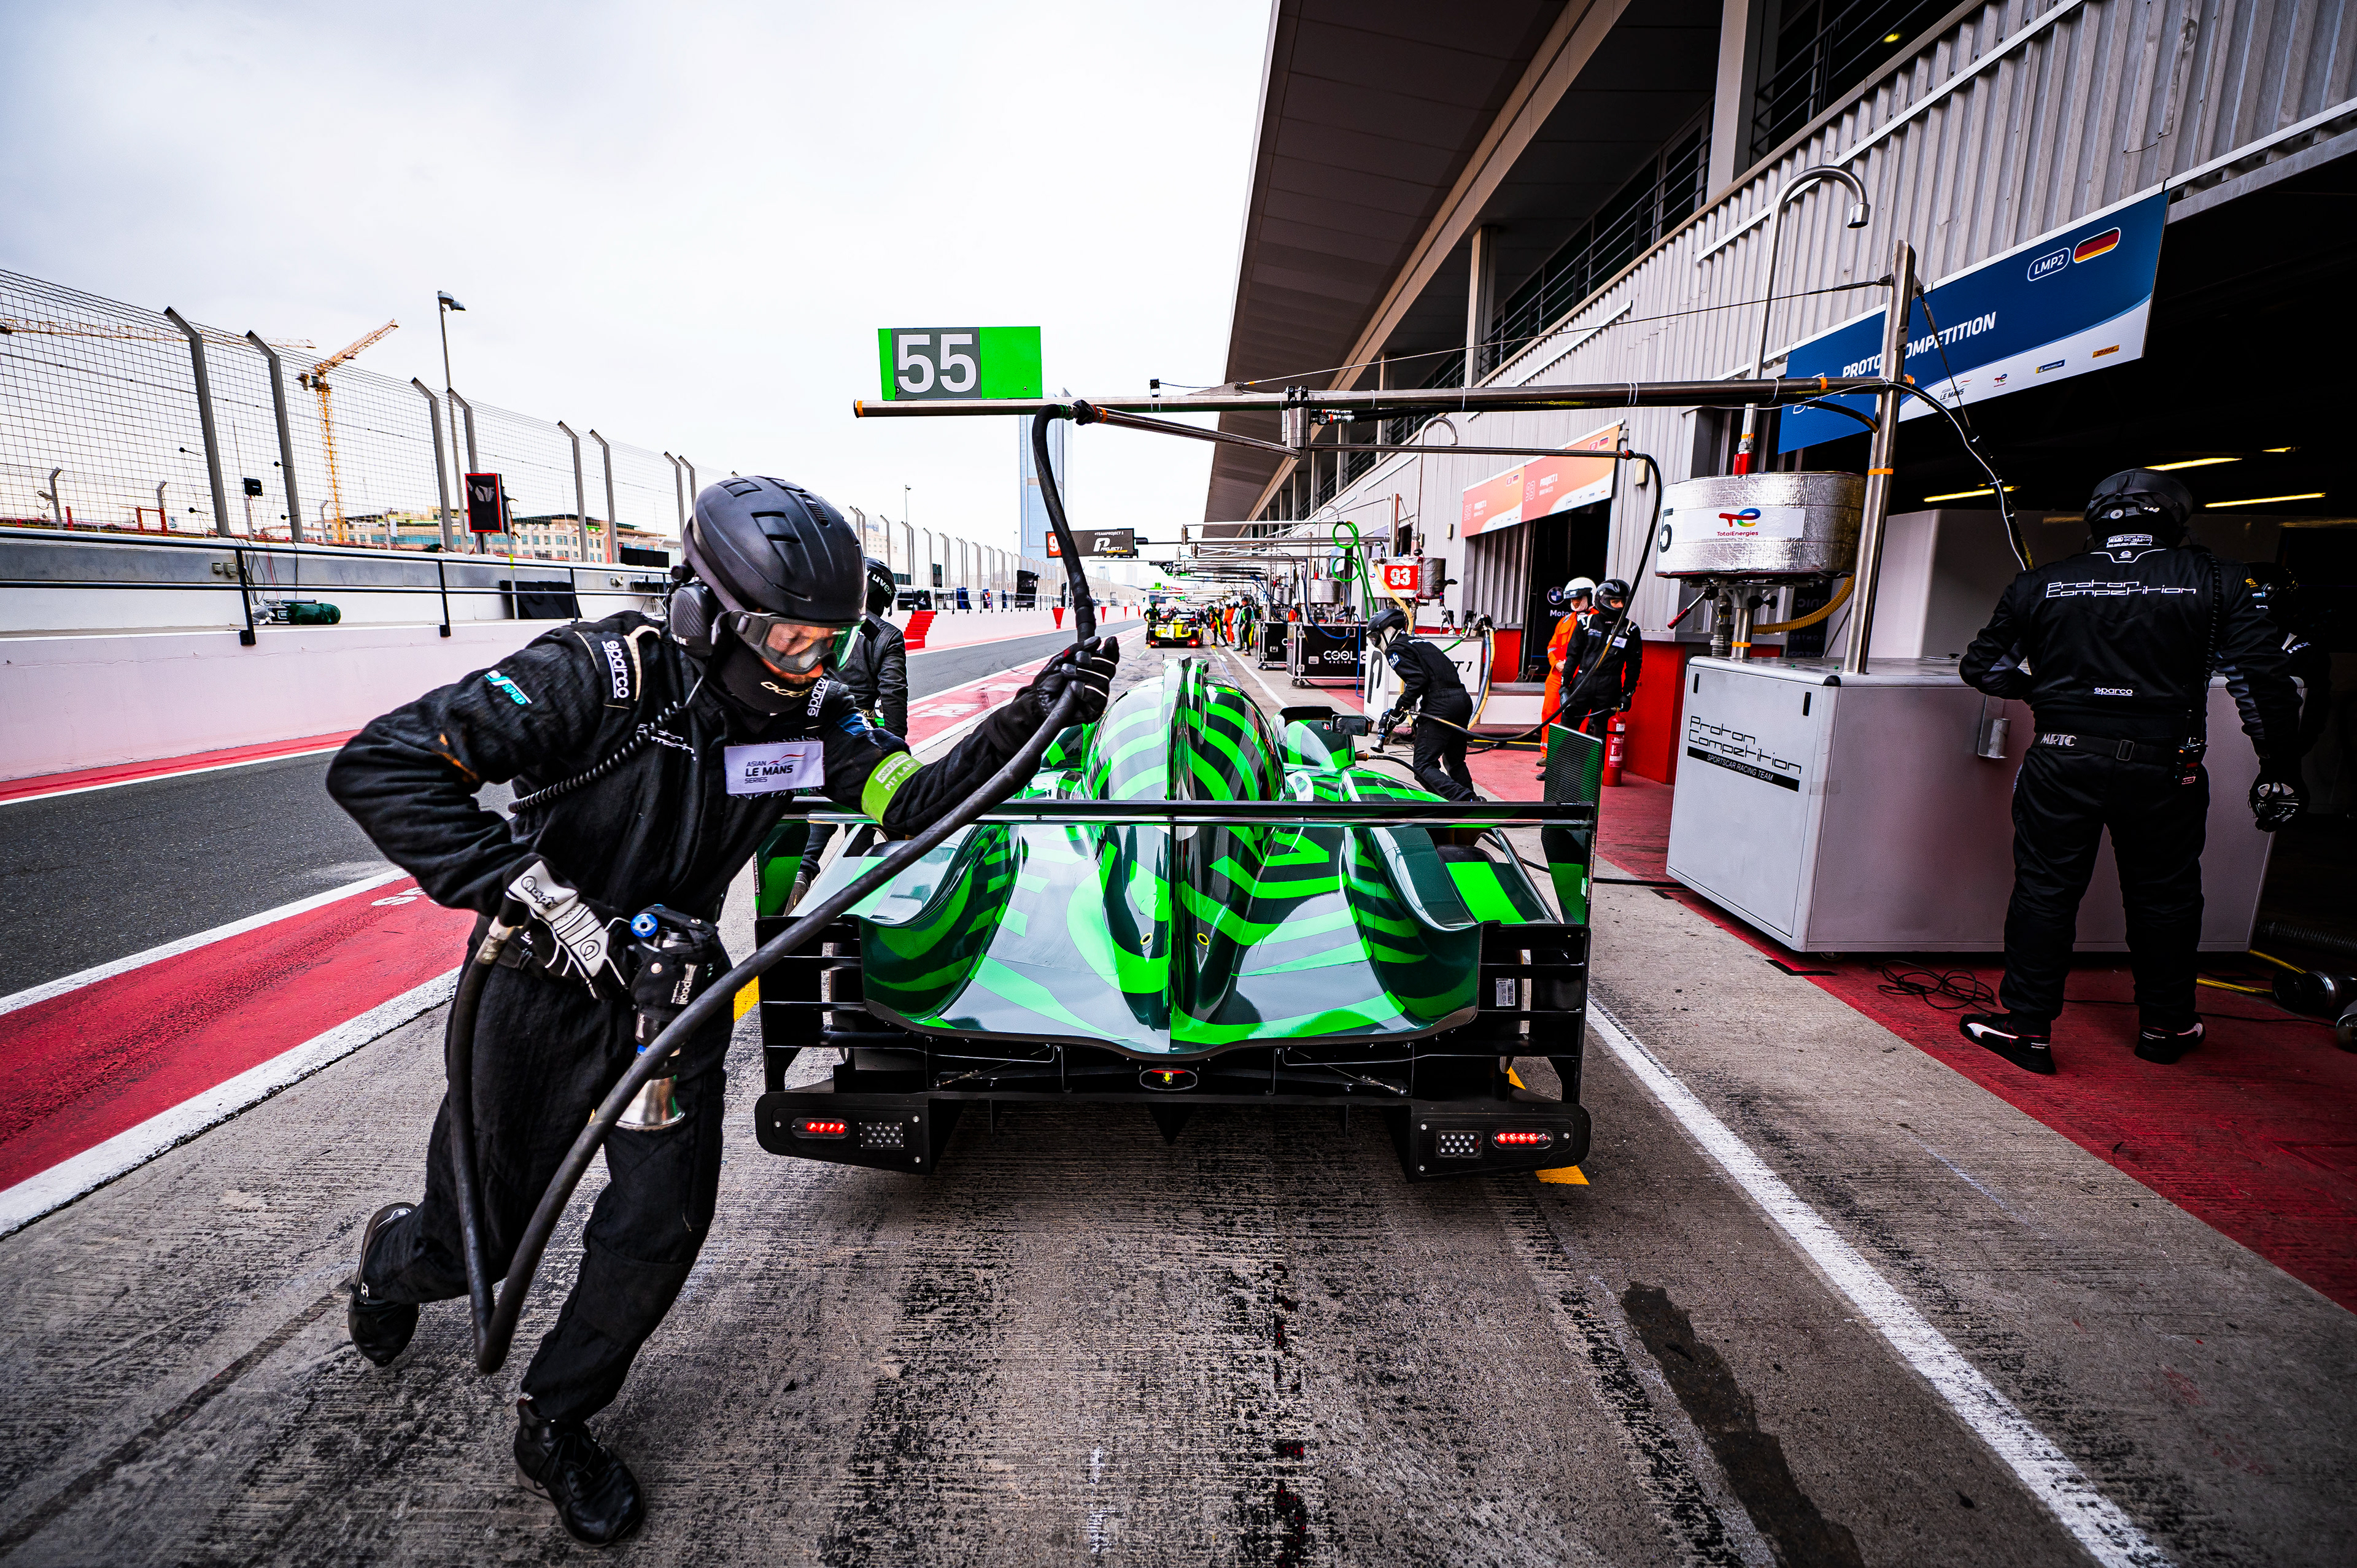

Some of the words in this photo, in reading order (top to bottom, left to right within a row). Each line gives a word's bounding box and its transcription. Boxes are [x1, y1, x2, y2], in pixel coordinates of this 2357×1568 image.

[2034, 254, 2064, 275] LMP2
[1842, 353, 1881, 377] PROTO
[1905, 312, 1997, 360] OMPETITION
[897, 333, 977, 393] 55
[1049, 535, 1059, 552] 9
[1390, 568, 1411, 585] 93
[2048, 579, 2140, 590] Proton
[872, 574, 893, 597] uvex
[2046, 585, 2197, 598] Competition
[1323, 651, 1357, 660] COOL
[2288, 642, 2311, 654] HRX
[602, 640, 630, 698] sparco
[2094, 687, 2133, 696] sparco
[1690, 715, 1755, 744] Proton
[2040, 733, 2077, 746] MRTC
[1689, 728, 1802, 774] Competition
[745, 767, 758, 777] LE
[762, 765, 793, 776] MANS
[1707, 754, 1736, 768] SPORTSCAR
[1736, 763, 1757, 776] RACING
[1757, 770, 1773, 781] TEAM
[884, 777, 897, 791] PIT
